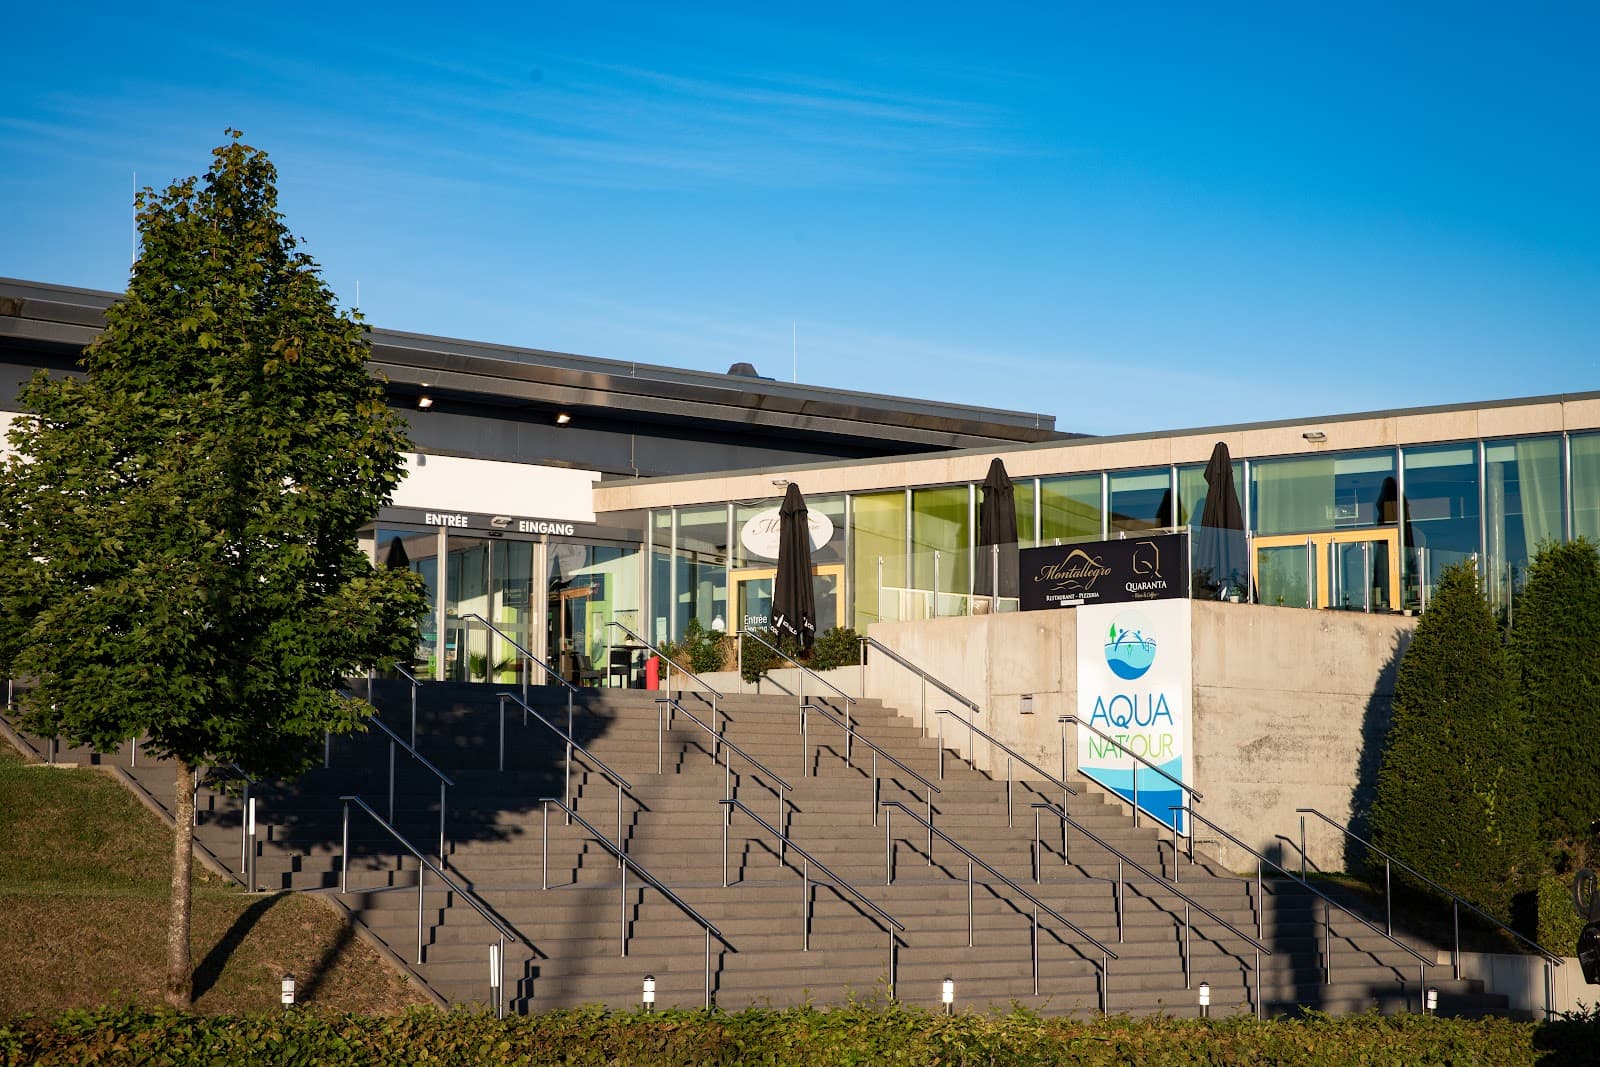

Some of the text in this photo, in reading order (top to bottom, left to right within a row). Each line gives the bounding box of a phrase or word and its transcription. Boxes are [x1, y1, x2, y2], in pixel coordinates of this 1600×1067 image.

[425, 512, 468, 528] ENTRÉE
[519, 520, 574, 536] EINGANG
[1034, 557, 1112, 590] Montallegro
[1125, 580, 1168, 592] QUARANTA
[744, 614, 768, 625] Entrée
[1089, 693, 1173, 729] AQUA
[1089, 734, 1174, 759] NAT'OUR
